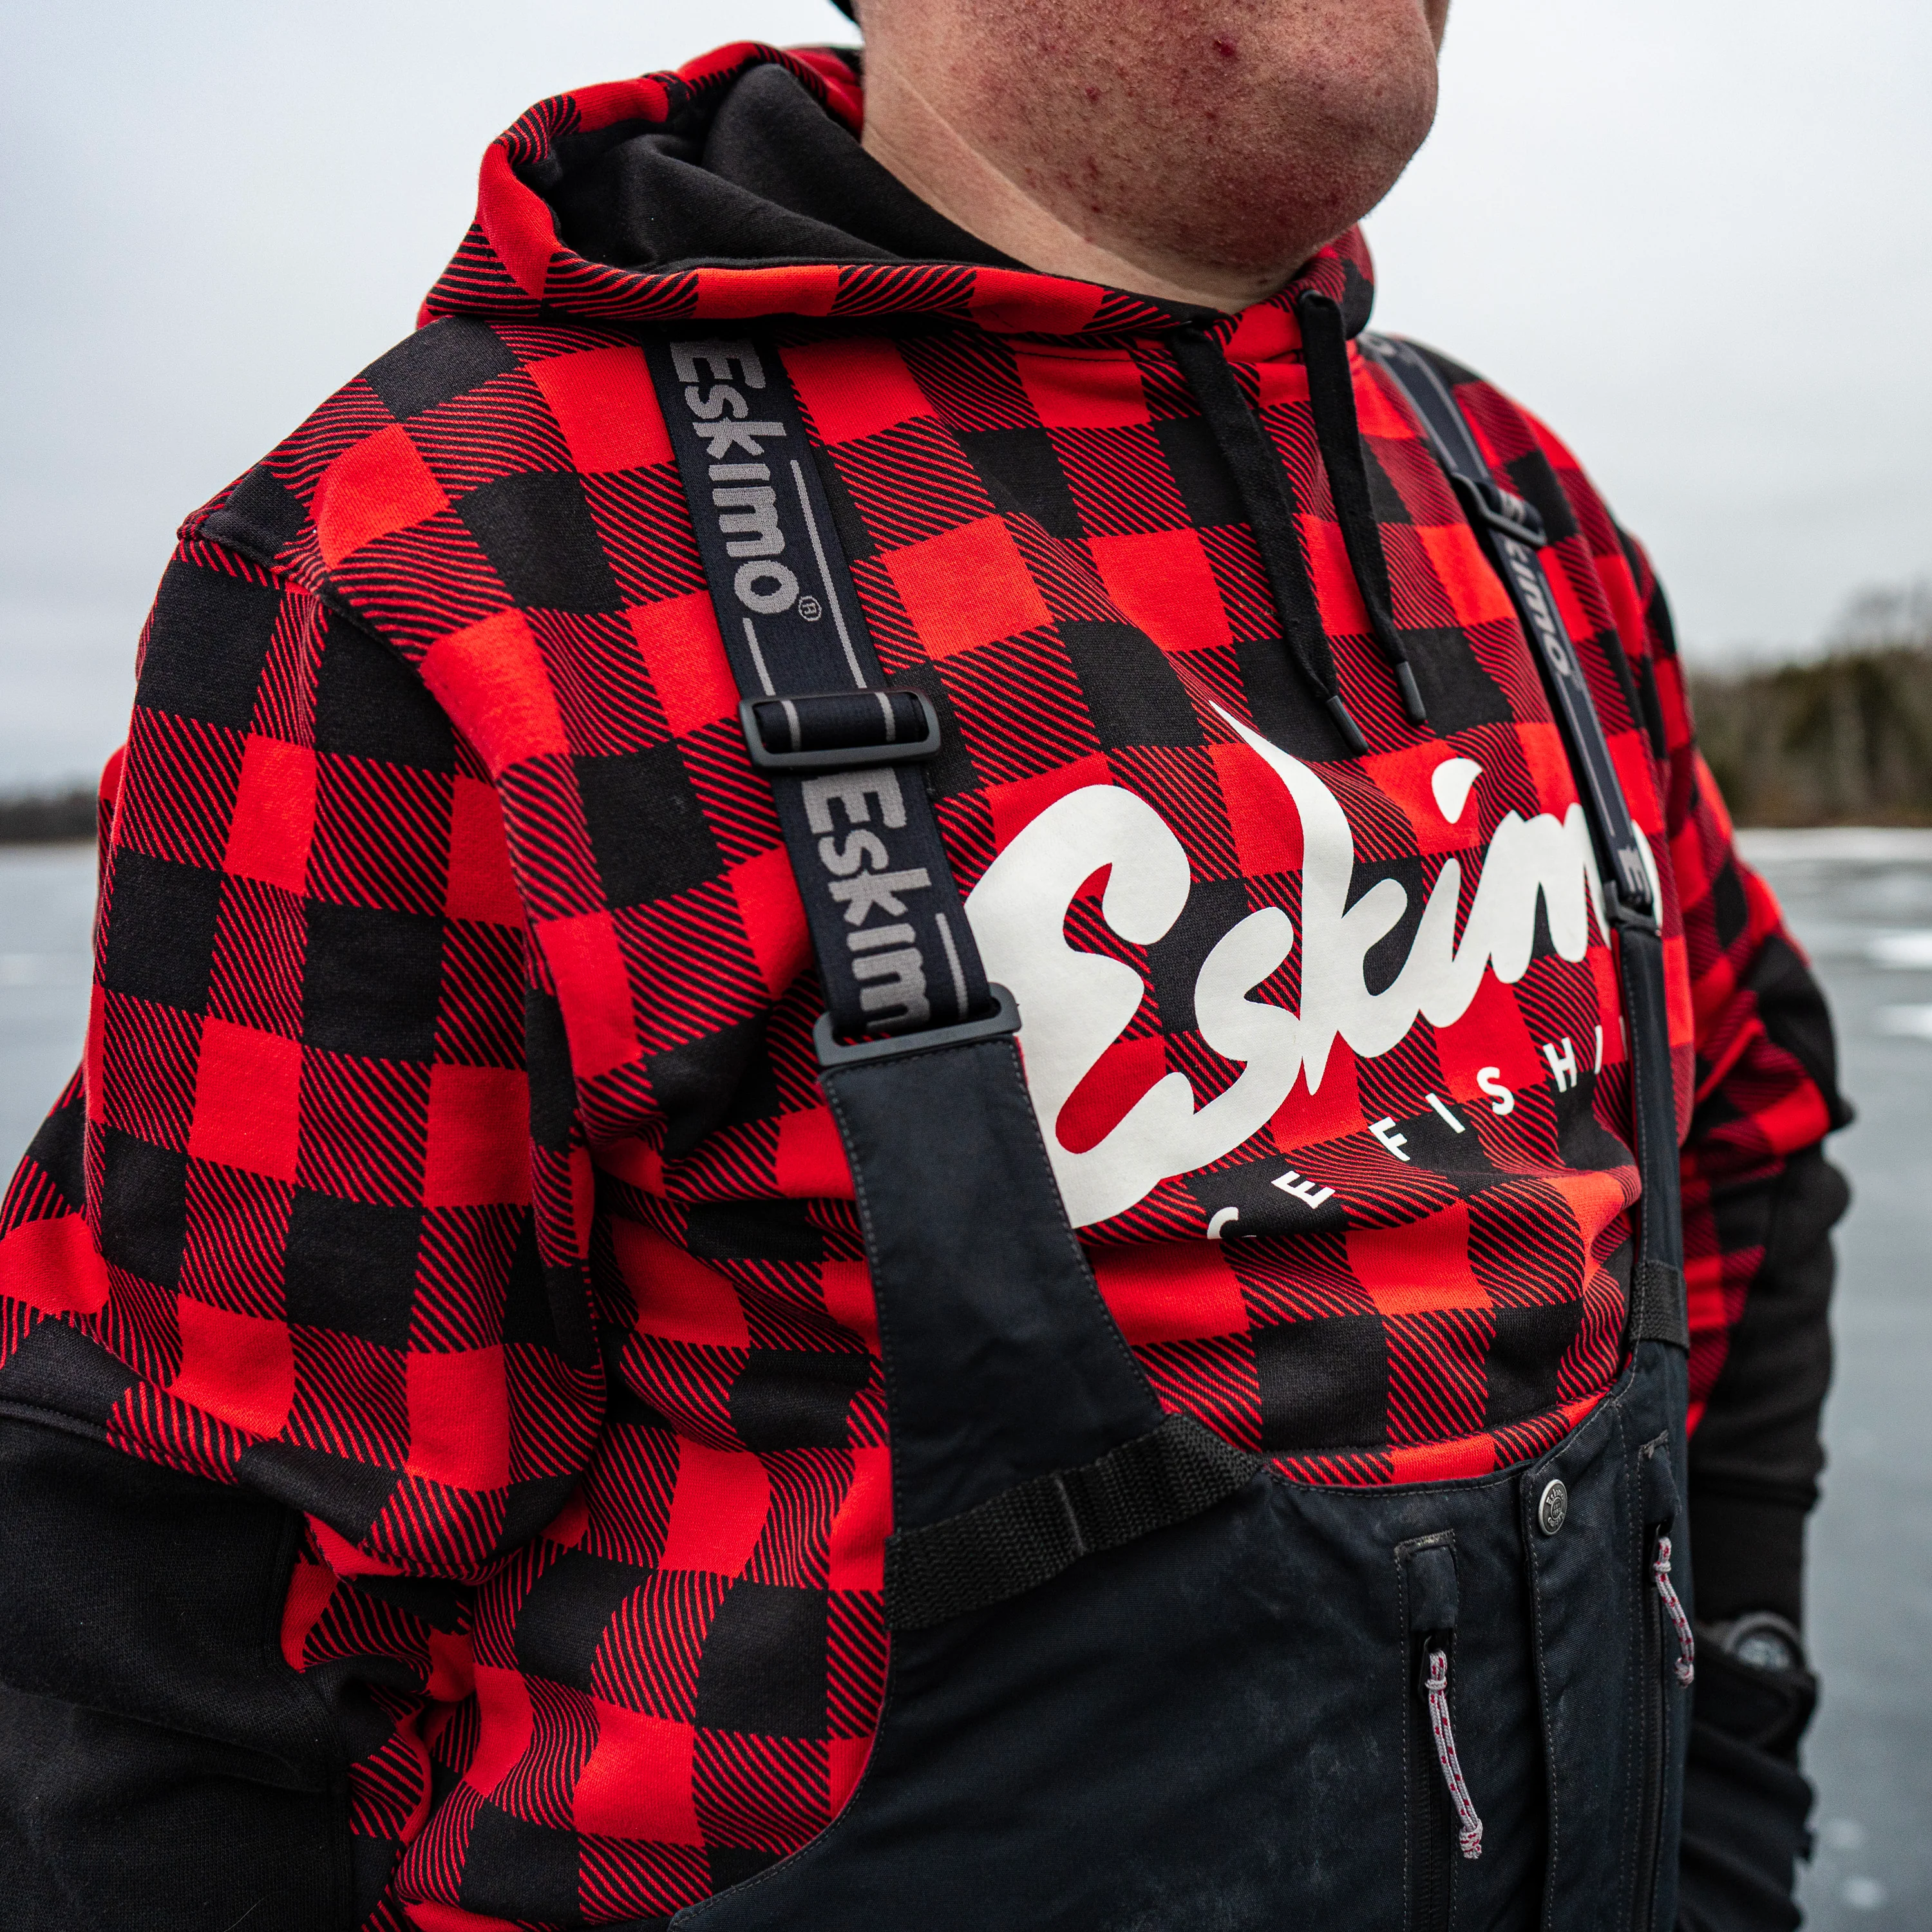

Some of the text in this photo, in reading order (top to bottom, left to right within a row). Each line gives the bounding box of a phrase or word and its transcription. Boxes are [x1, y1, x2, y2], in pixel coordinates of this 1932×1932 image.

[670, 339, 799, 614] Eskimo
[963, 699, 1663, 1229] Eskim
[1368, 1015, 1628, 1161] FISHI
